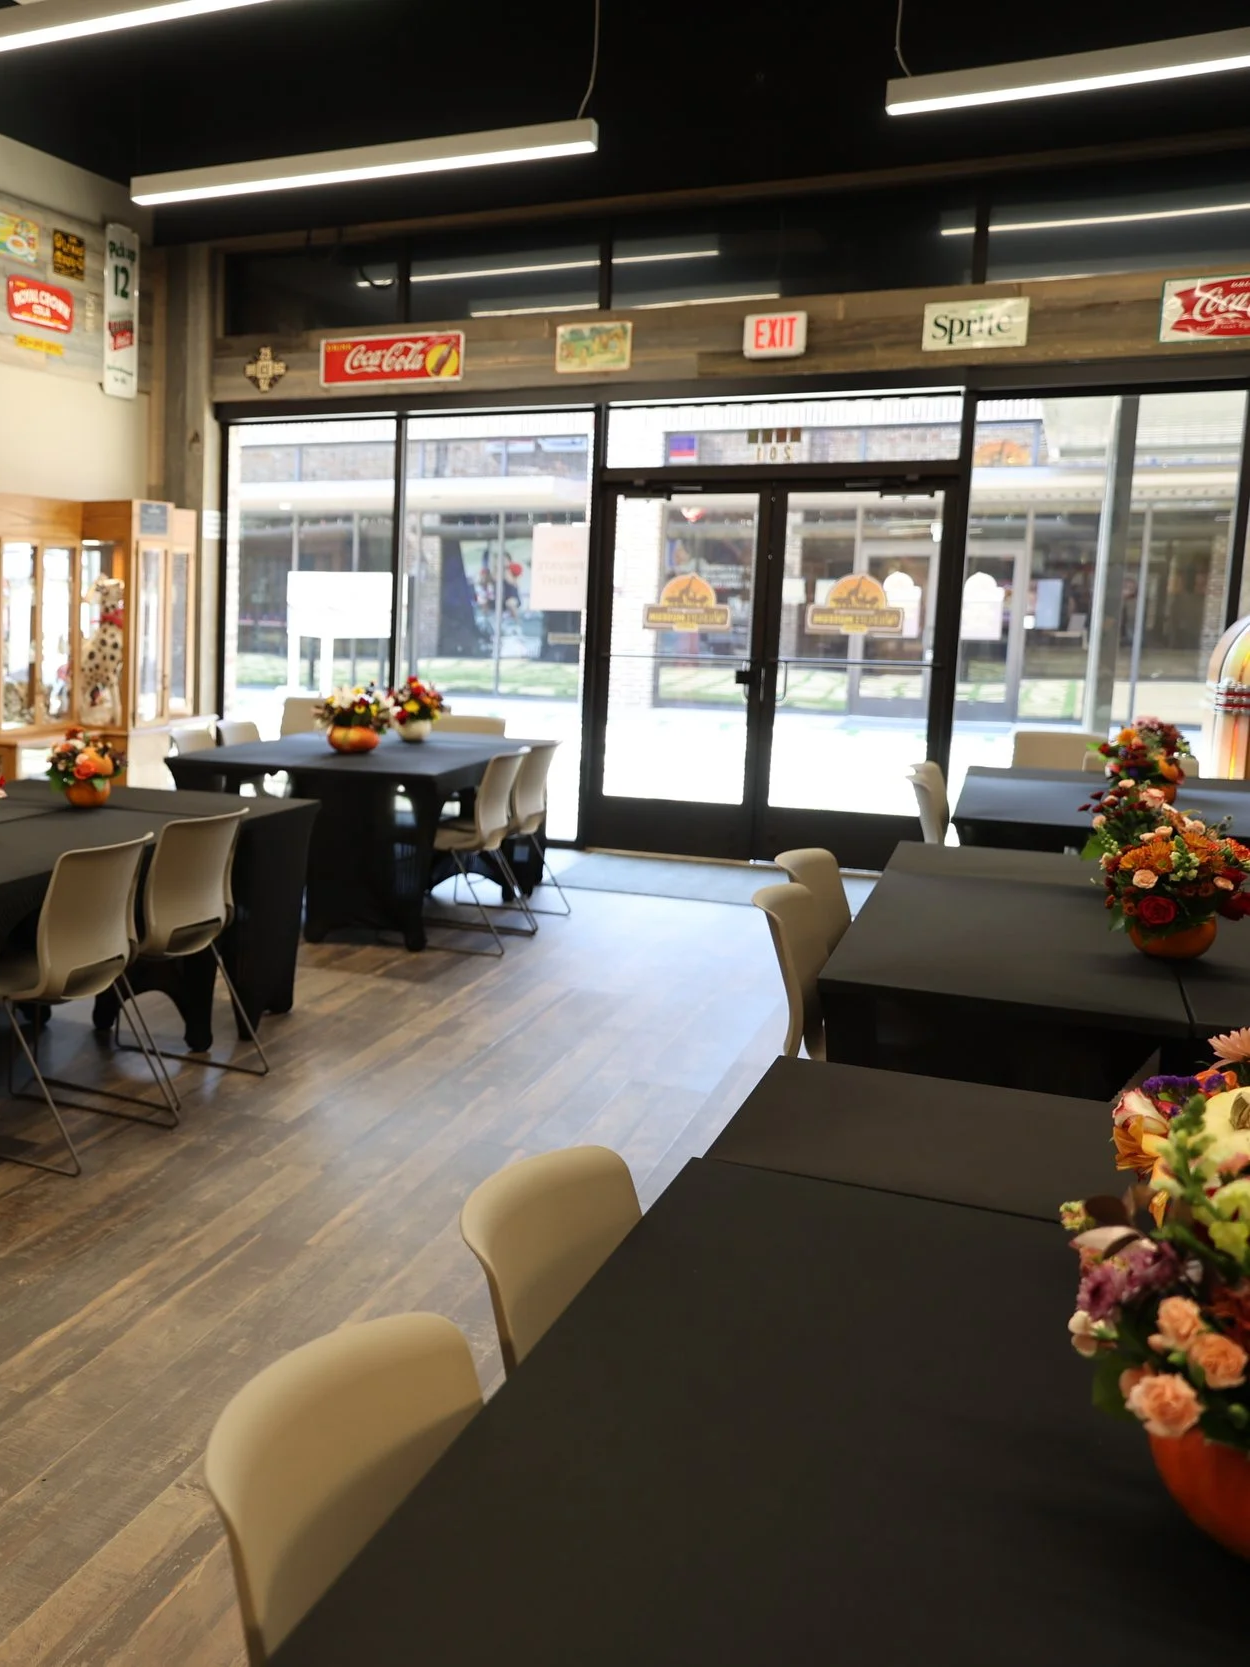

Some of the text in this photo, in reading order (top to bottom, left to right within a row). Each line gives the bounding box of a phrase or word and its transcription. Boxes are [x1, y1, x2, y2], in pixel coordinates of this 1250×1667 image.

[114, 264, 130, 299] 12
[13, 288, 39, 307] ROYAL
[39, 290, 71, 320] CROWN
[32, 304, 52, 318] COLA
[754, 317, 798, 349] EXIT
[931, 313, 1012, 345] Sprite
[344, 340, 428, 375] Coca-Cola
